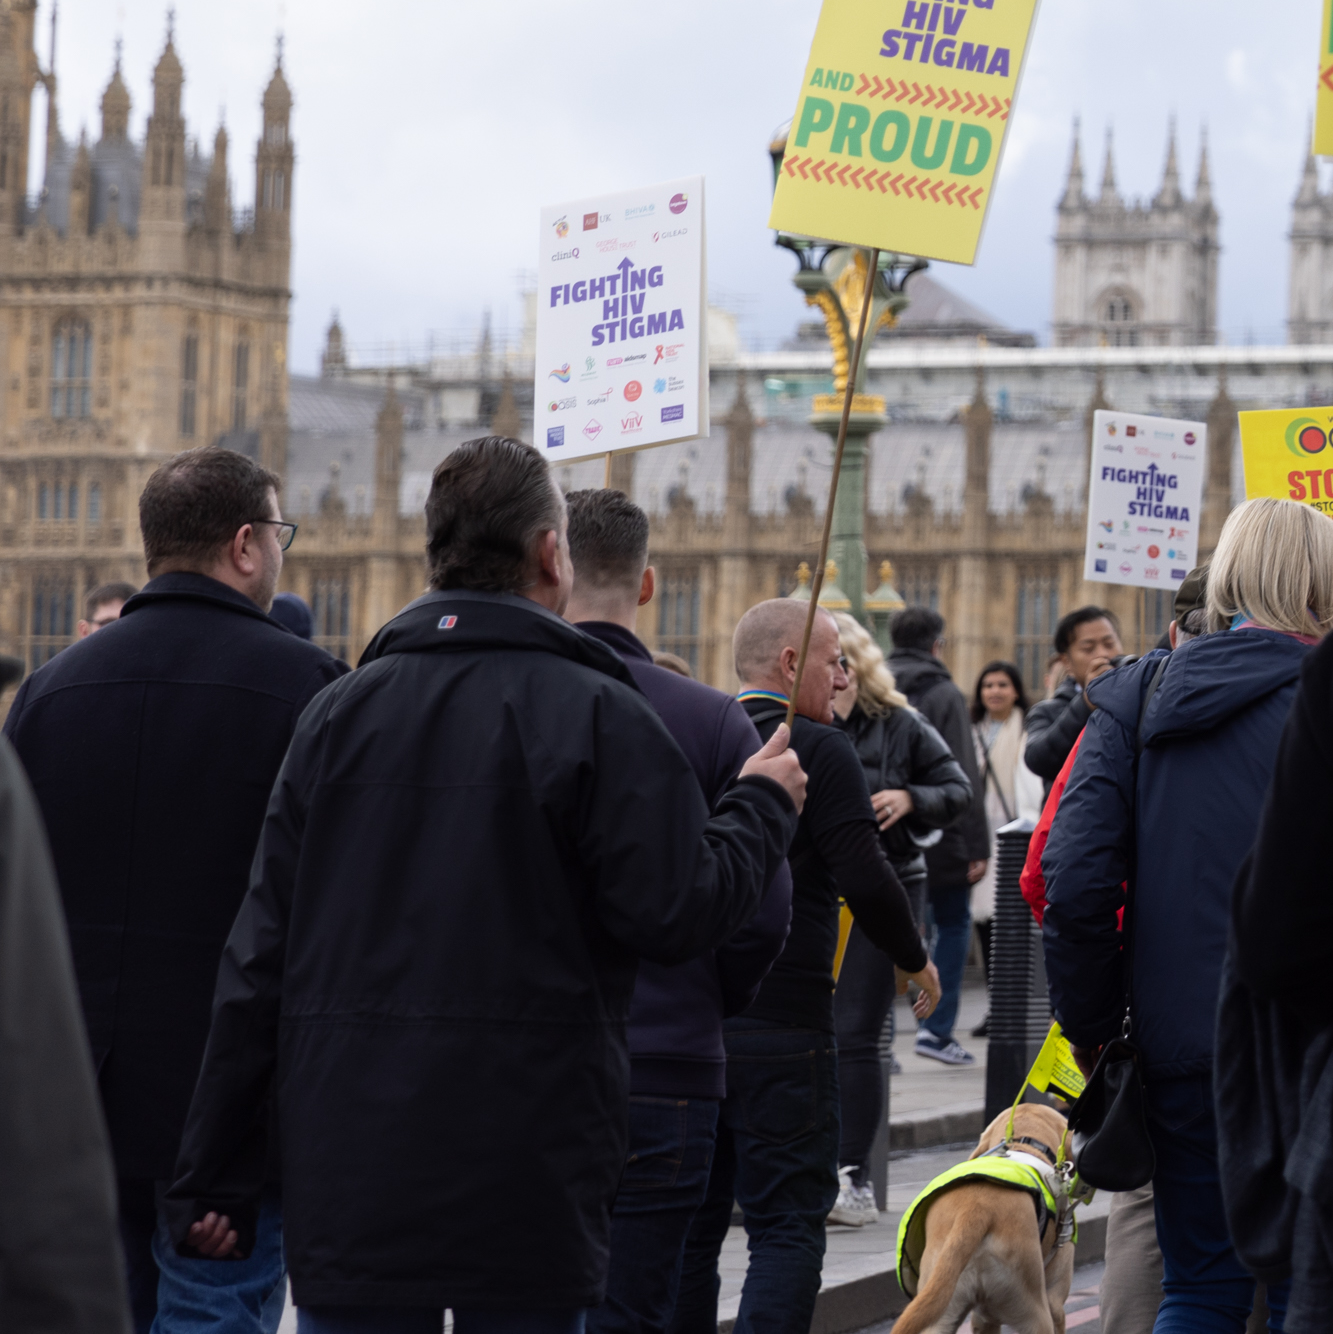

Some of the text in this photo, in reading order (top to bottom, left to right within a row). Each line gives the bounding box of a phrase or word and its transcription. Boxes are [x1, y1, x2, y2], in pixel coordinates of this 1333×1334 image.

[901, 0, 967, 37] HIV
[879, 29, 1011, 78] STIGMA
[809, 67, 856, 93] AND
[794, 97, 993, 177] PROUD
[661, 228, 688, 239] GILEAD
[549, 265, 664, 308] FIGHTING
[602, 292, 646, 322] HIV
[591, 309, 685, 347] STIGMA
[1101, 466, 1178, 489] FIGHTING
[1136, 486, 1166, 503] HIV
[1128, 501, 1190, 522] STIGMA
